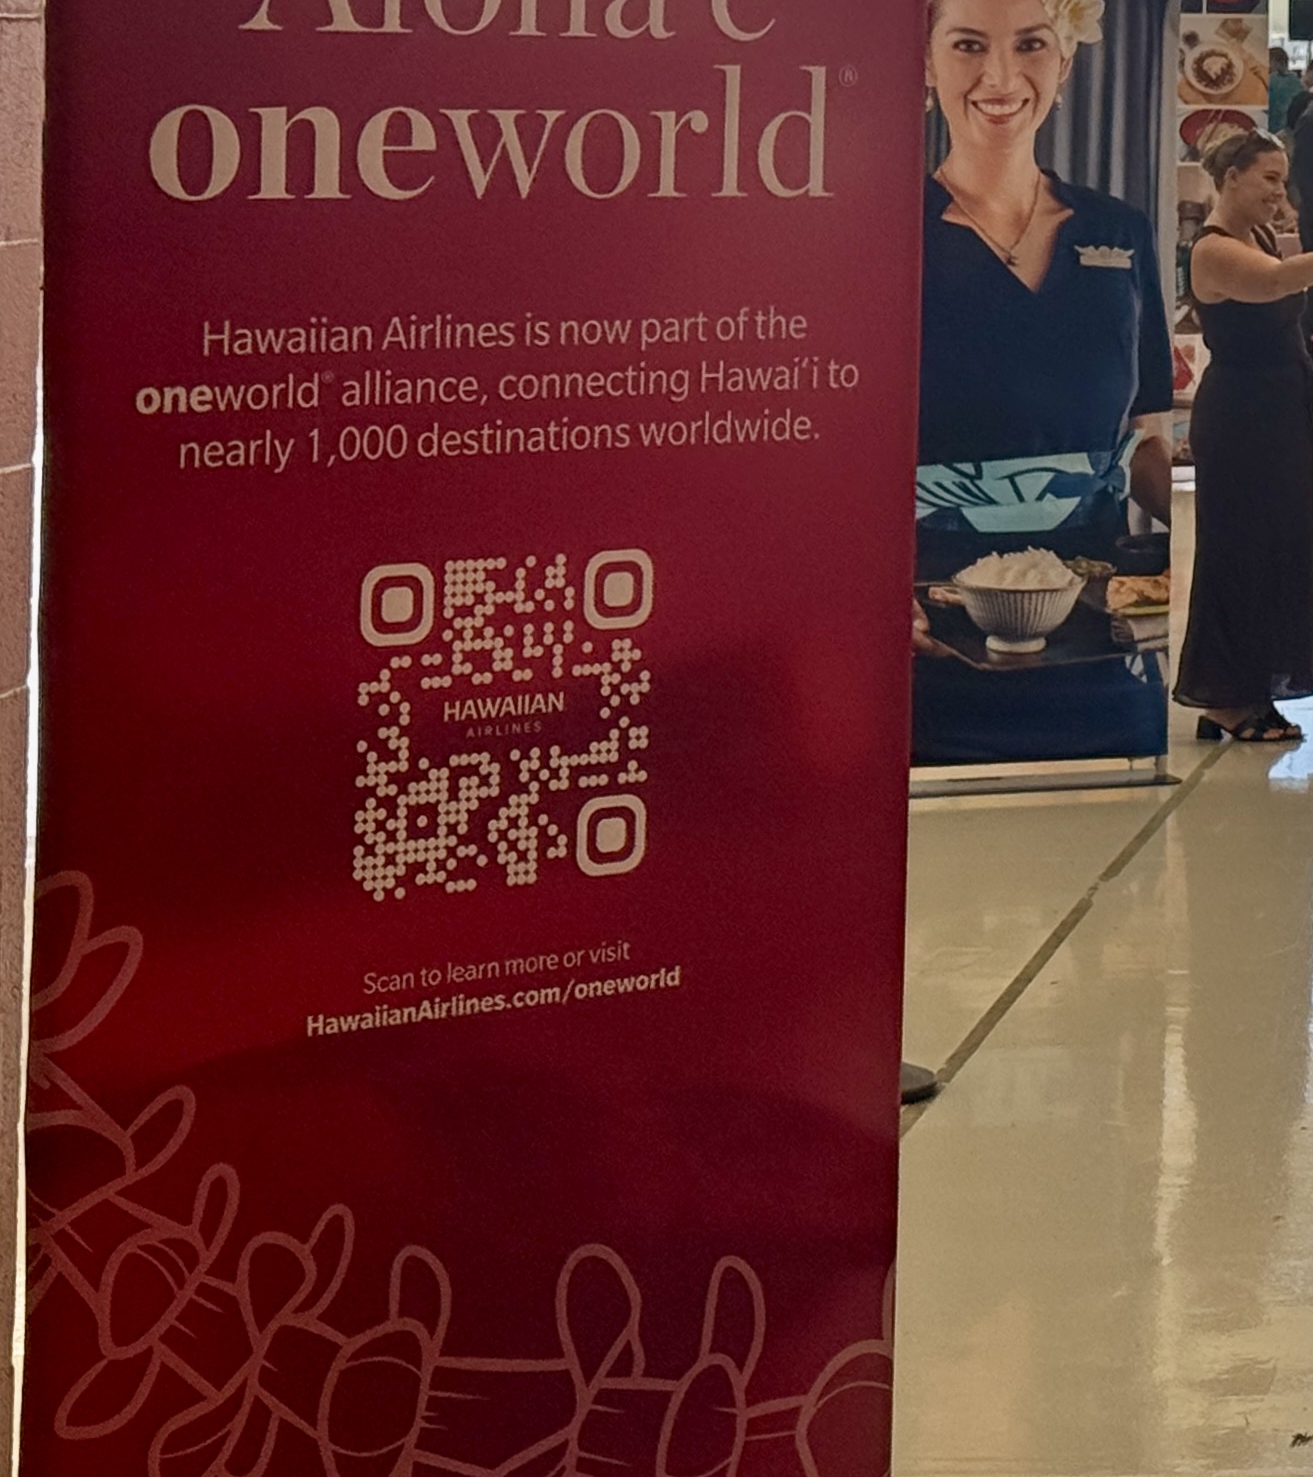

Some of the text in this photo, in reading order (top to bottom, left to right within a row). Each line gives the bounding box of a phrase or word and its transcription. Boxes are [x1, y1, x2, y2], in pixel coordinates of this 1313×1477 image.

[204, 306, 807, 355] Hawaiian Airlines is now part of the
[342, 370, 487, 406] alliance,
[499, 366, 689, 401] connecting
[828, 360, 859, 388] to
[180, 408, 819, 473] nearly 1,000 destinations worldwide.
[444, 692, 564, 721] HAWAIIAN
[467, 721, 541, 737] AIRLINES
[364, 942, 630, 994] Scan to learn more or visit
[307, 962, 680, 1036] HawaiianAirlines.com/oneworld
